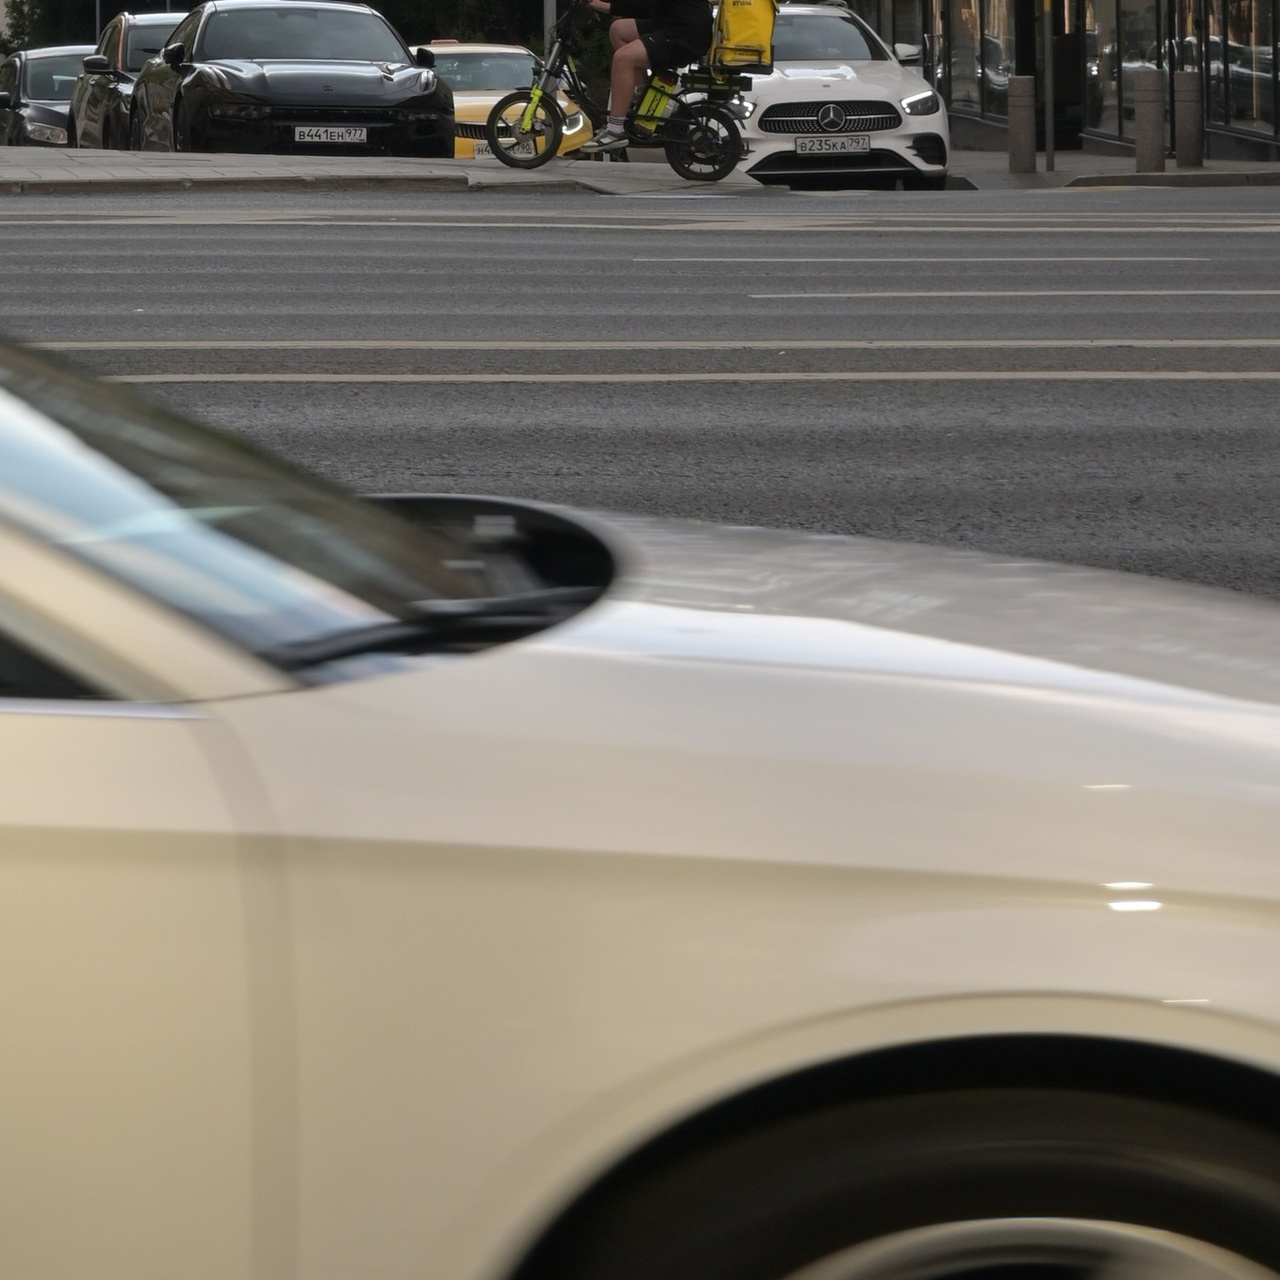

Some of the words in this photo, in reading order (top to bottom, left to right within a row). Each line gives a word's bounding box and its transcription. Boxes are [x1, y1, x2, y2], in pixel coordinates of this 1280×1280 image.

[299, 128, 344, 141] В441ЕН
[346, 128, 364, 138] 977
[800, 139, 847, 152] В235КА
[848, 137, 866, 147] 797
